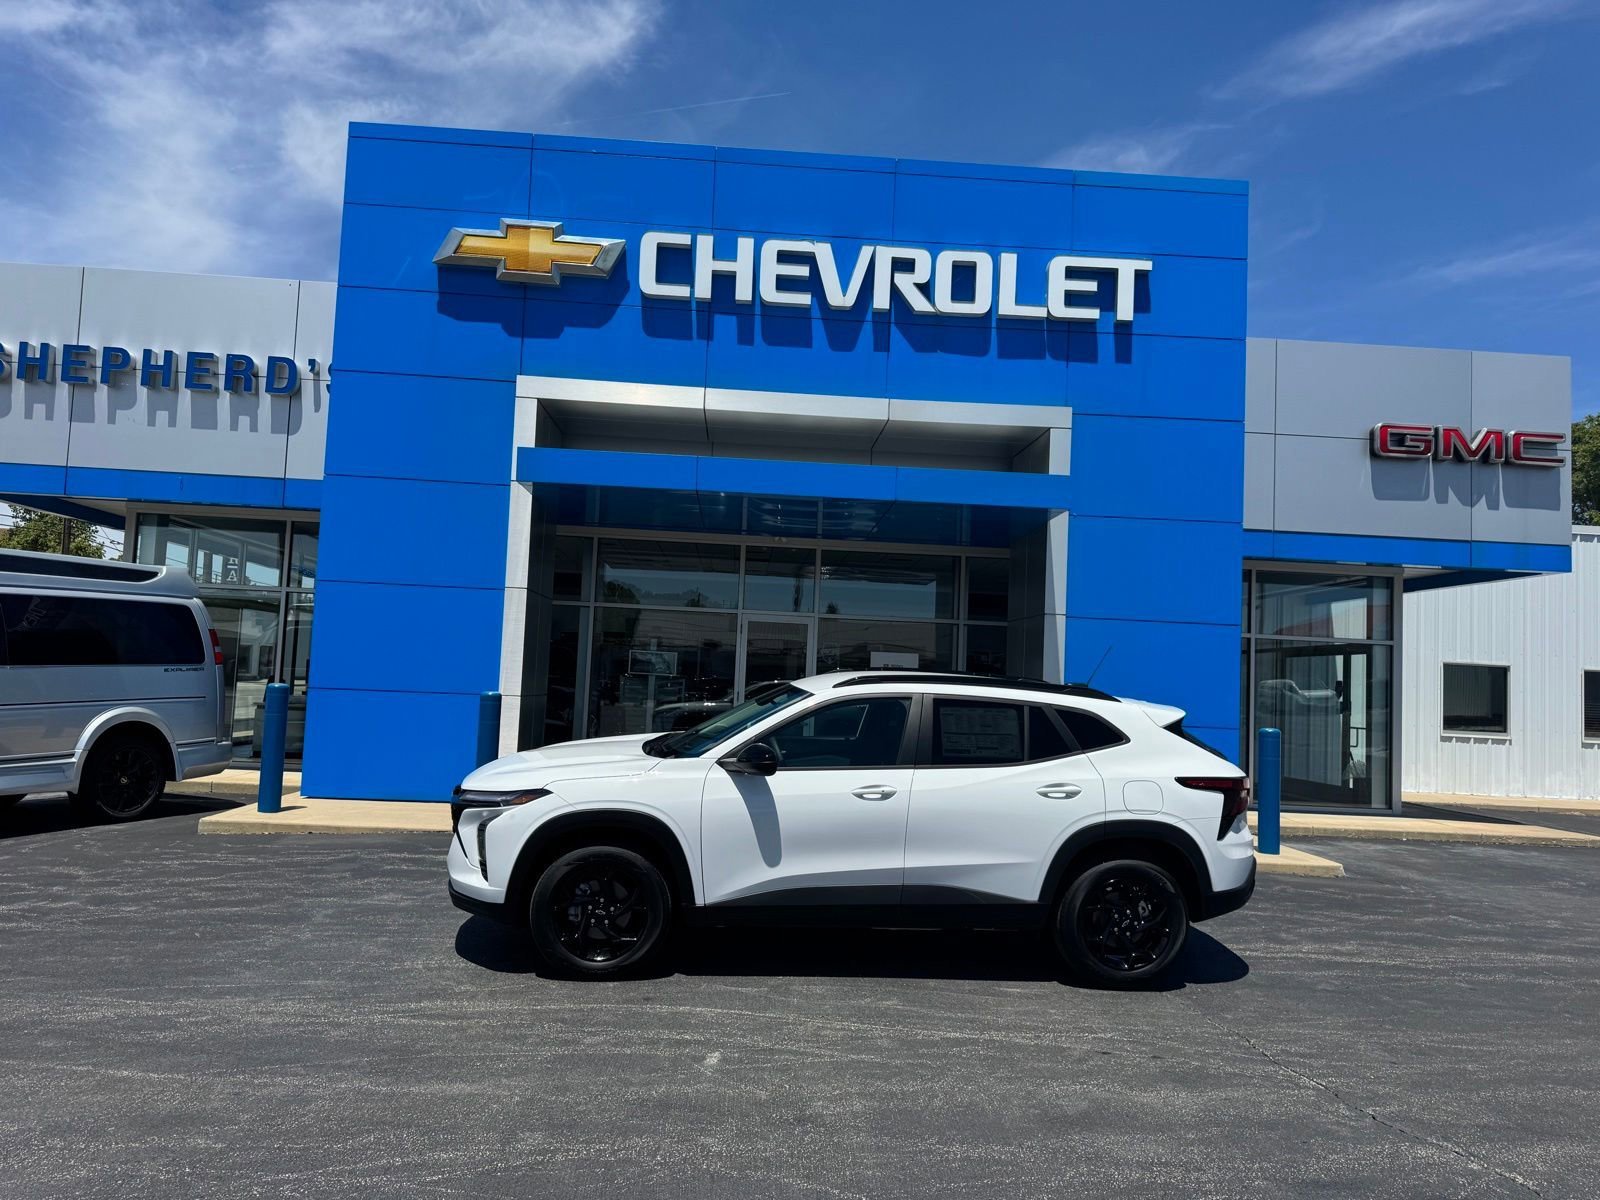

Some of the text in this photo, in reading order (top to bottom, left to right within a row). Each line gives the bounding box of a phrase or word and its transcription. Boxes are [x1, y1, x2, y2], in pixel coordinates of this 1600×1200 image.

[639, 231, 1152, 322] CHEVROLET
[0, 341, 332, 395] HEPHERD'
[1372, 422, 1566, 467] GMC
